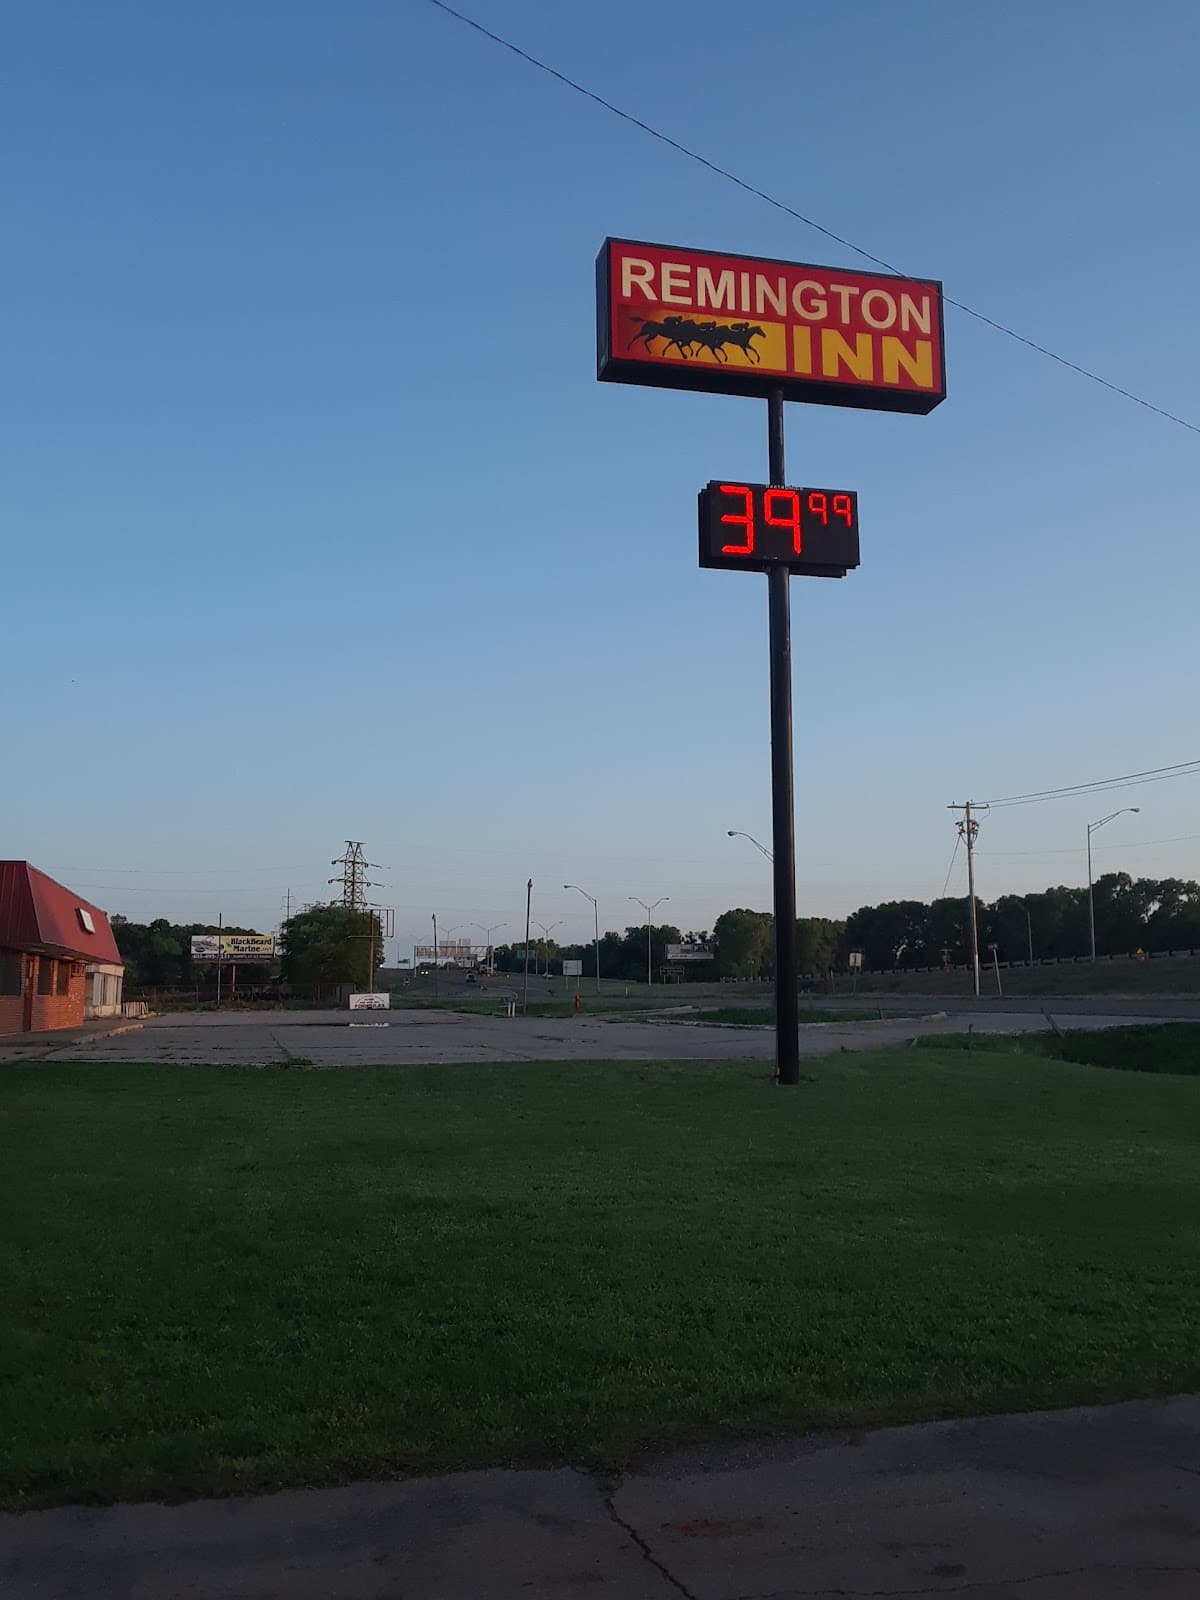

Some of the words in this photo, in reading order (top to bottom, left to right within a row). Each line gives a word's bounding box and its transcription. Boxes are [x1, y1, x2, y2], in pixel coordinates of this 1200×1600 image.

[621, 257, 931, 334] REMINGTON
[793, 325, 934, 389] INN
[719, 484, 802, 555] 39
[808, 492, 852, 528] 99
